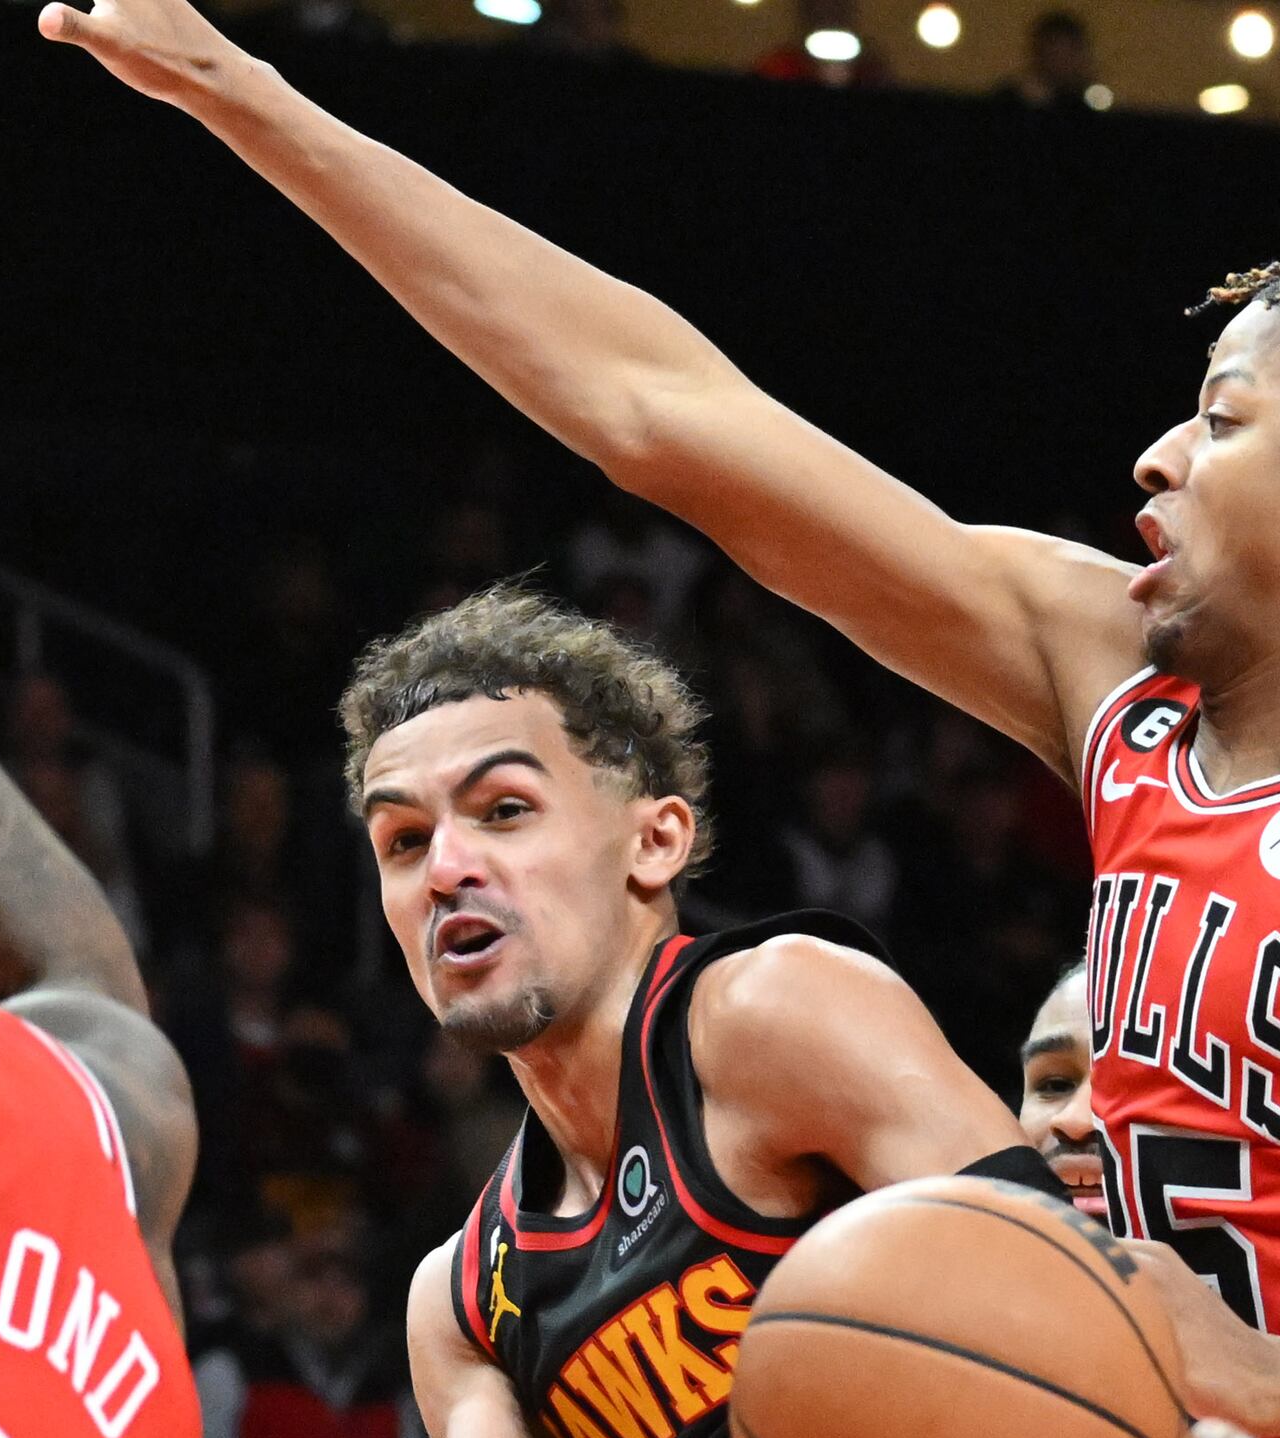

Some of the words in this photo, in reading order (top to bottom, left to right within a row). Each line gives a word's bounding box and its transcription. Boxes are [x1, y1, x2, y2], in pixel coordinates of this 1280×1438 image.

[1130, 706, 1182, 749] 6
[616, 1193, 666, 1257] sharecare
[1091, 1112, 1269, 1336] 5
